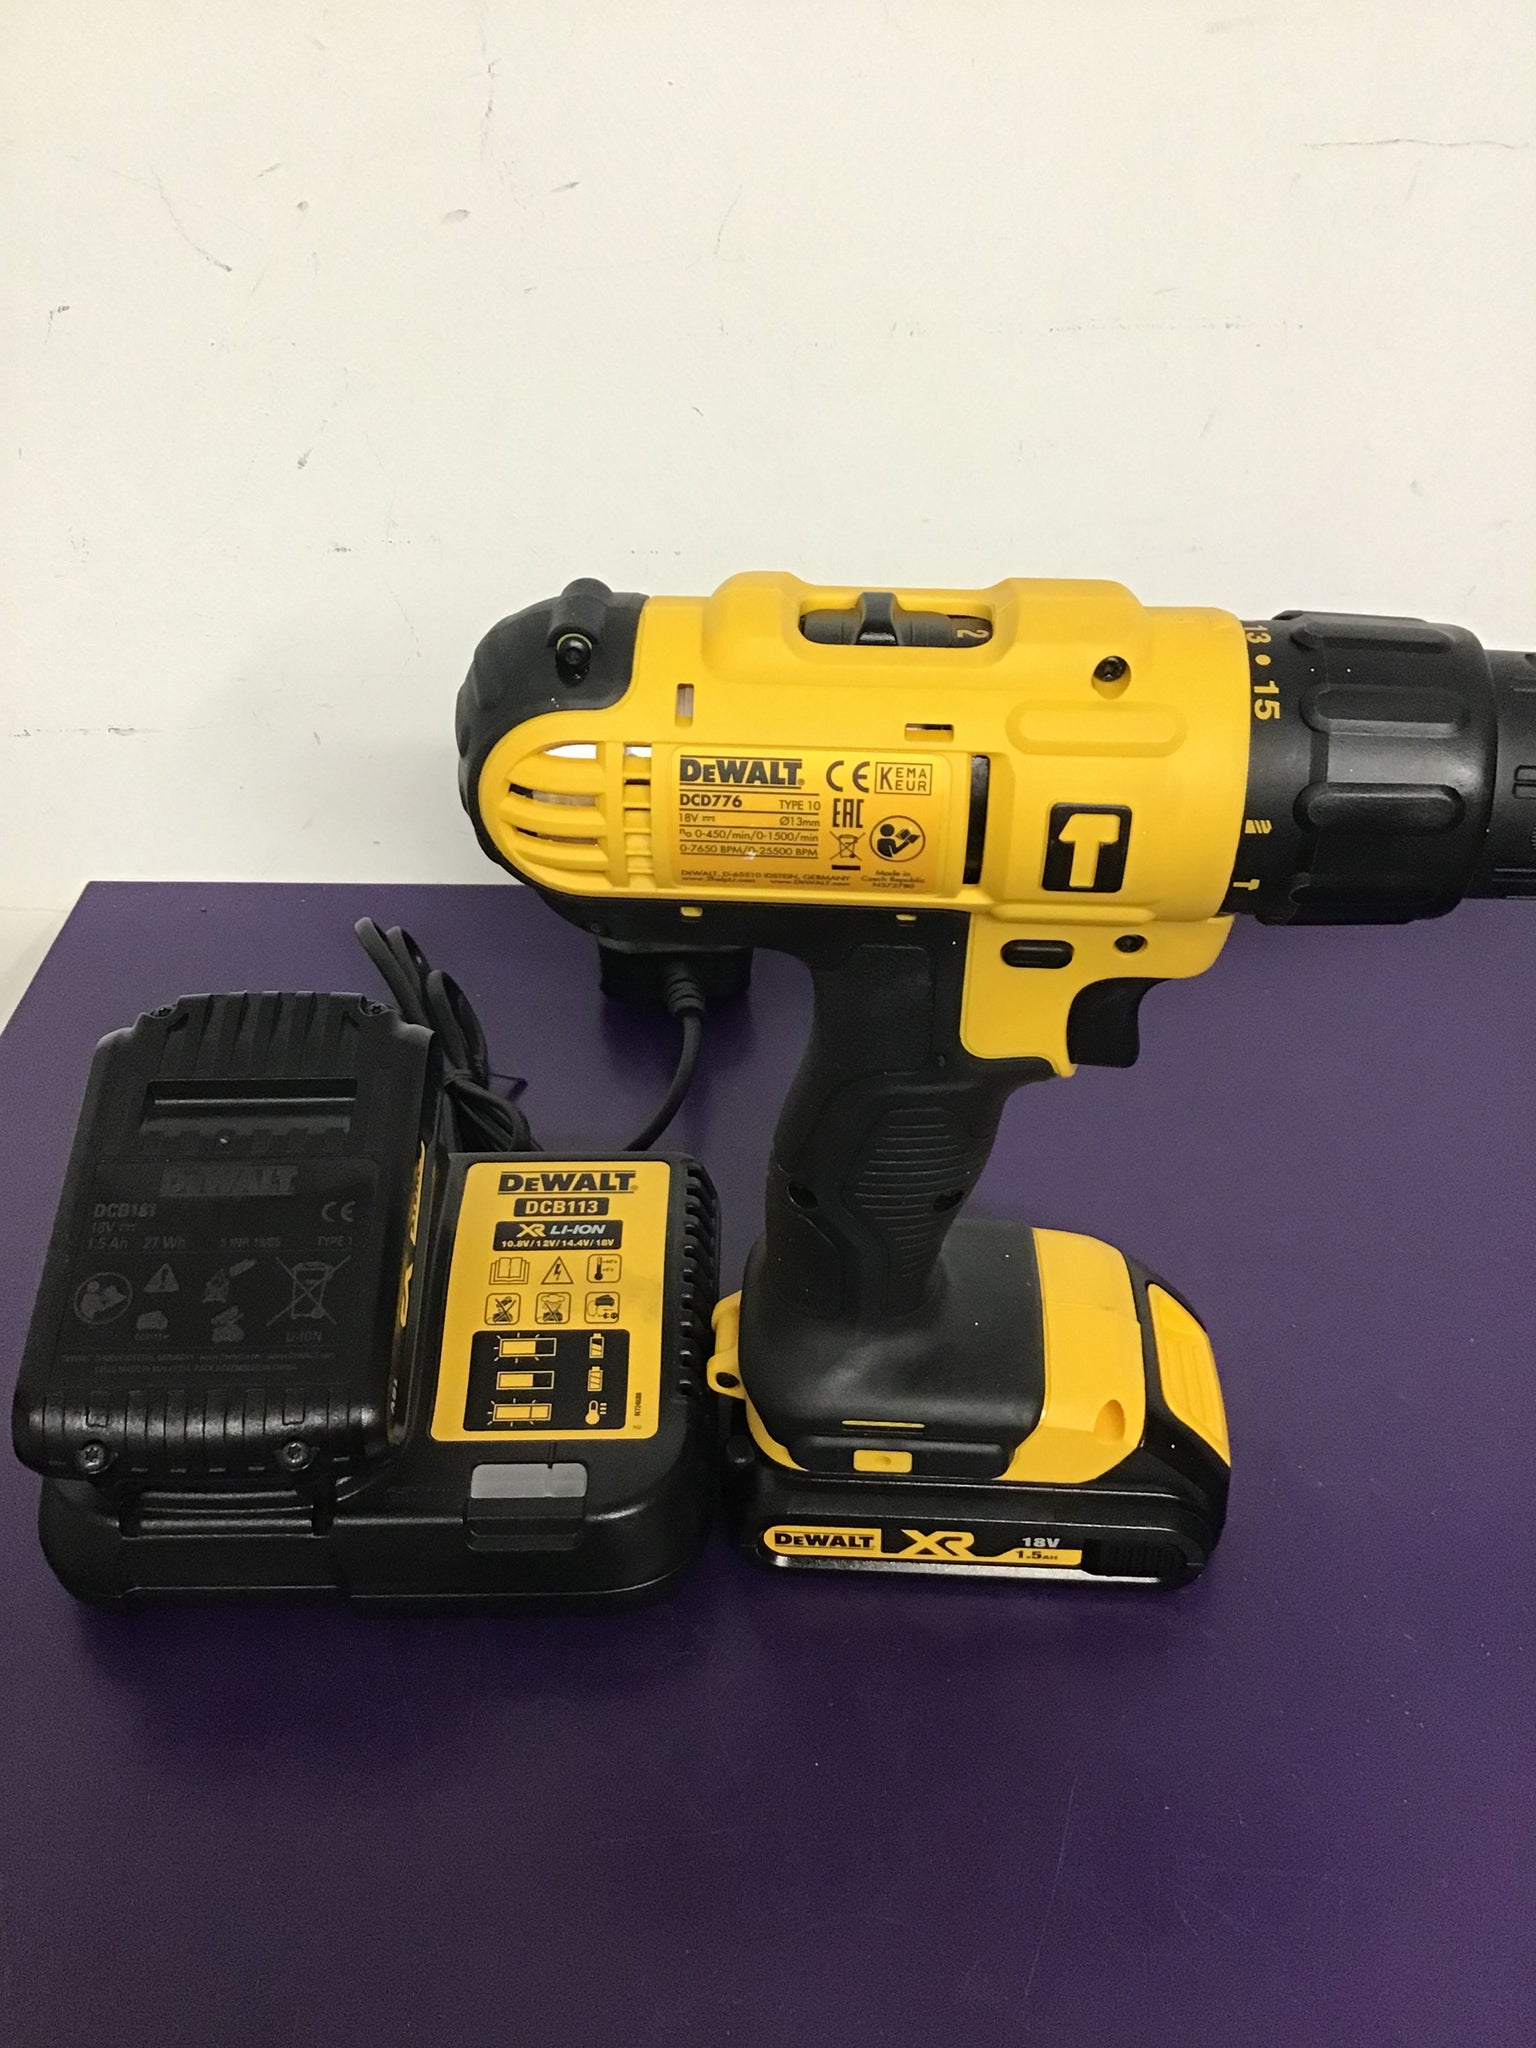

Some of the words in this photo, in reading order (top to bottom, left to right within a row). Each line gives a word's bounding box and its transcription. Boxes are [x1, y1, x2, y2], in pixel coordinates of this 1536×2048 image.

[956, 629, 989, 639] 2
[1254, 680, 1280, 720] 15
[680, 793, 743, 809] DCD776
[779, 799, 804, 811] TYPE
[808, 800, 821, 811] 10
[679, 812, 699, 823] 18V
[680, 844, 718, 854] 0-7650
[796, 848, 818, 857] BPM
[525, 1200, 599, 1215] DCB113
[516, 1223, 545, 1238] XR
[550, 1224, 606, 1235] LI-ION
[900, 1529, 975, 1556] XR
[1022, 1537, 1060, 1548] 18V
